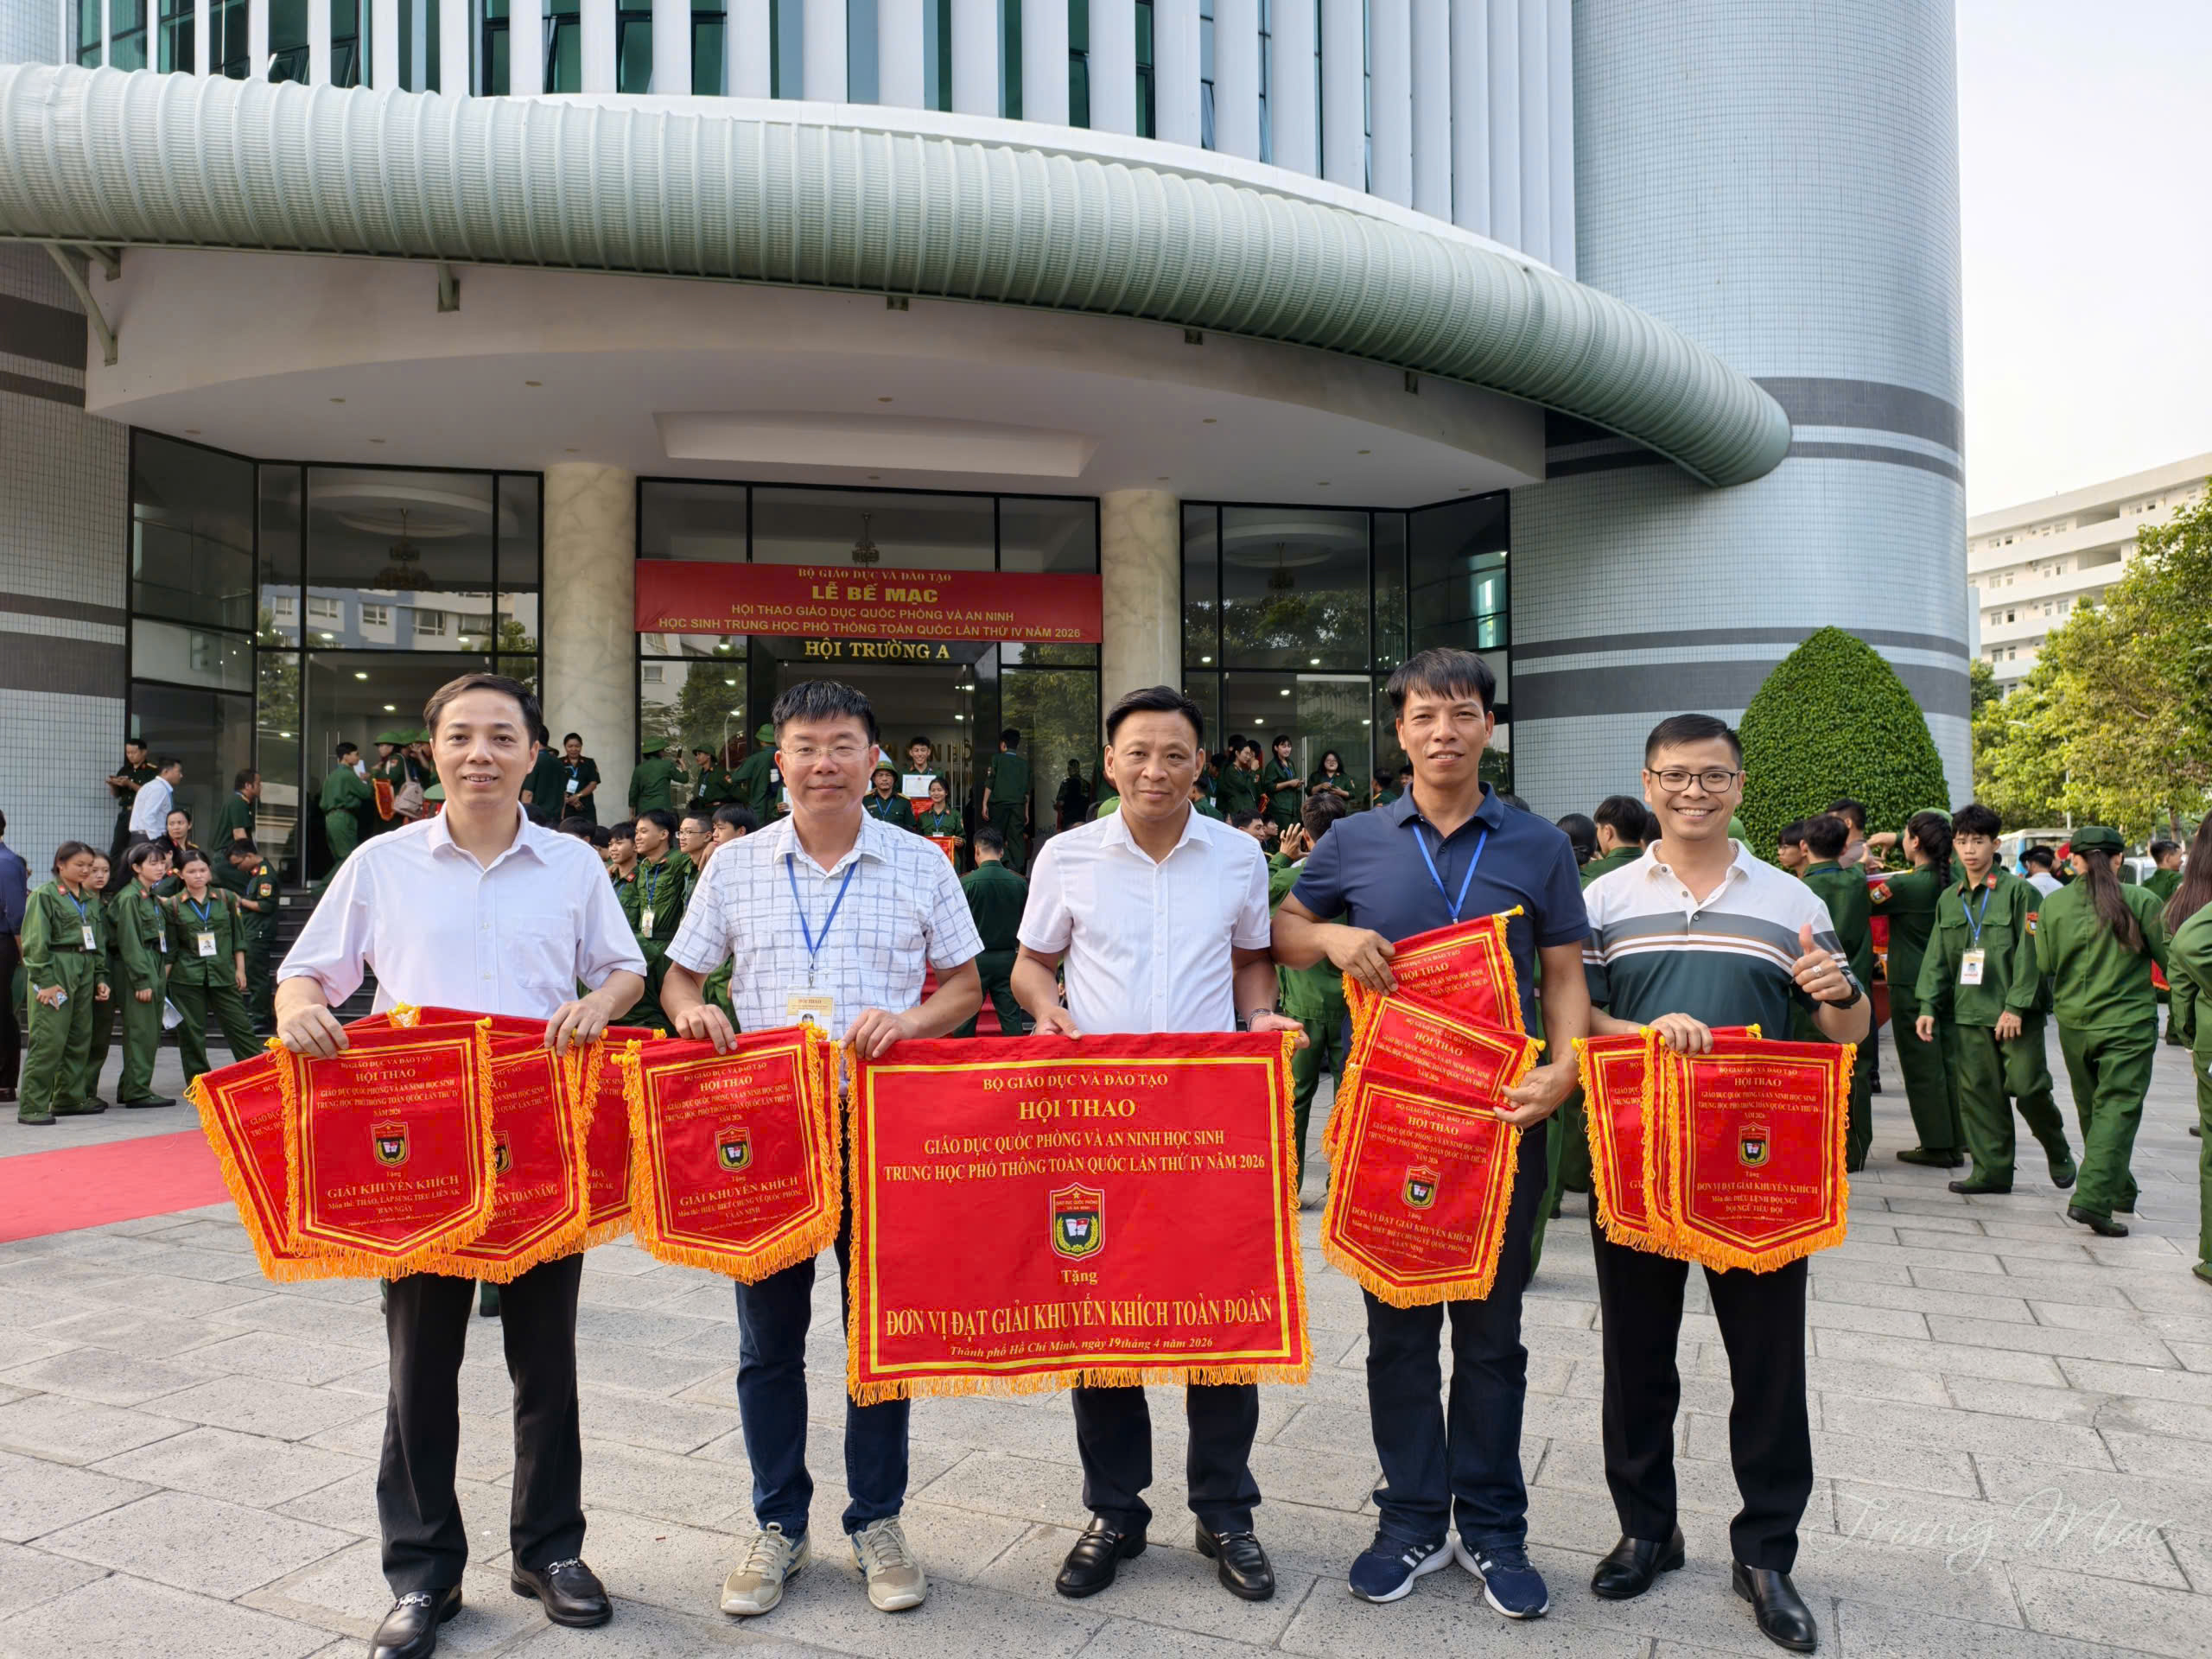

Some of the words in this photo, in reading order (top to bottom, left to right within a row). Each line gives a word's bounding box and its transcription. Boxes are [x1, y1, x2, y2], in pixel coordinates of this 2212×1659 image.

[811, 581, 839, 600] LỄ
[847, 582, 877, 601] BẾ
[885, 588, 938, 605] MẠC
[732, 603, 753, 615] HỘI
[757, 605, 792, 615] THAO
[796, 605, 827, 616] GIÁO
[830, 607, 856, 619] DỤC
[860, 607, 896, 620] QUỐC
[899, 607, 943, 620] PHÒNG
[947, 608, 963, 620] VÀ
[965, 611, 982, 621] AN
[985, 612, 1014, 622] NINH
[1011, 627, 1022, 636] IV
[1055, 628, 1080, 638] 2026
[804, 637, 841, 659] HỘI
[849, 639, 931, 658] TRƯỜNG
[936, 645, 950, 658] A
[1400, 970, 1418, 982] HỘI
[1421, 962, 1449, 976] THAO
[1414, 1032, 1434, 1045] HỘI
[1435, 1039, 1464, 1057] THAO
[356, 1071, 378, 1084] HỘI
[380, 1068, 416, 1080] THAO
[700, 1080, 721, 1092] HỘI
[722, 1075, 753, 1089] THAO
[983, 1077, 1004, 1092] BỘ
[1007, 1074, 1044, 1090] GIÁO
[1048, 1074, 1077, 1089] DỤC
[1081, 1071, 1100, 1085] VÀ
[1104, 1071, 1135, 1086] ĐÀO
[1138, 1073, 1168, 1089] TẠO
[1019, 1097, 1060, 1123] HỘI
[1067, 1098, 1135, 1117] THAO
[1408, 1116, 1428, 1128] HỘI
[1430, 1122, 1459, 1135] THAO
[925, 1135, 961, 1154] GIÁO
[963, 1138, 993, 1156] DỤC
[995, 1130, 1033, 1153] QUỐC
[1036, 1129, 1081, 1149] PHÒNG
[1085, 1128, 1103, 1147] VÀ
[1105, 1133, 1123, 1147] AN
[1127, 1131, 1160, 1146] NINH
[1163, 1130, 1192, 1149] HỌC
[1194, 1130, 1224, 1145] SINH
[884, 1166, 931, 1181] TRUNG
[935, 1165, 965, 1183] HỌC
[969, 1159, 996, 1179] PHỔ
[999, 1156, 1046, 1176] THÔNG
[1048, 1153, 1084, 1173] TOÀN
[1087, 1152, 1127, 1174] QUỐC
[1129, 1153, 1157, 1172] LẦN
[1159, 1152, 1189, 1171] THỨ
[1190, 1156, 1205, 1170] IV
[1207, 1152, 1236, 1170] NĂM
[1240, 1154, 1265, 1168] 2026
[327, 1185, 357, 1198] GIẢI
[359, 1179, 413, 1195] KHUYẾN
[416, 1175, 459, 1190] KHÍCH
[1061, 1269, 1098, 1286] Tặng
[886, 1308, 925, 1336] ĐƠN
[928, 1311, 947, 1341] VỊ
[950, 1310, 988, 1343] ĐẠT
[992, 1299, 1030, 1335] GIẢI
[1033, 1292, 1106, 1331] KHUYẾN
[1110, 1294, 1168, 1327] KHÍCH
[1172, 1292, 1221, 1326] TOÀN
[1224, 1289, 1272, 1324] ĐOÀN
[950, 1345, 983, 1357] Thành
[986, 1343, 1007, 1360] phố
[1009, 1341, 1025, 1355] Hồ
[1027, 1339, 1046, 1353] Chí
[1081, 1338, 1106, 1350] ngày
[1109, 1338, 1121, 1348] 19
[1121, 1338, 1151, 1350] tháng
[1154, 1338, 1160, 1348] 4
[1163, 1338, 1186, 1348] năm
[1189, 1338, 1213, 1348] 2026
